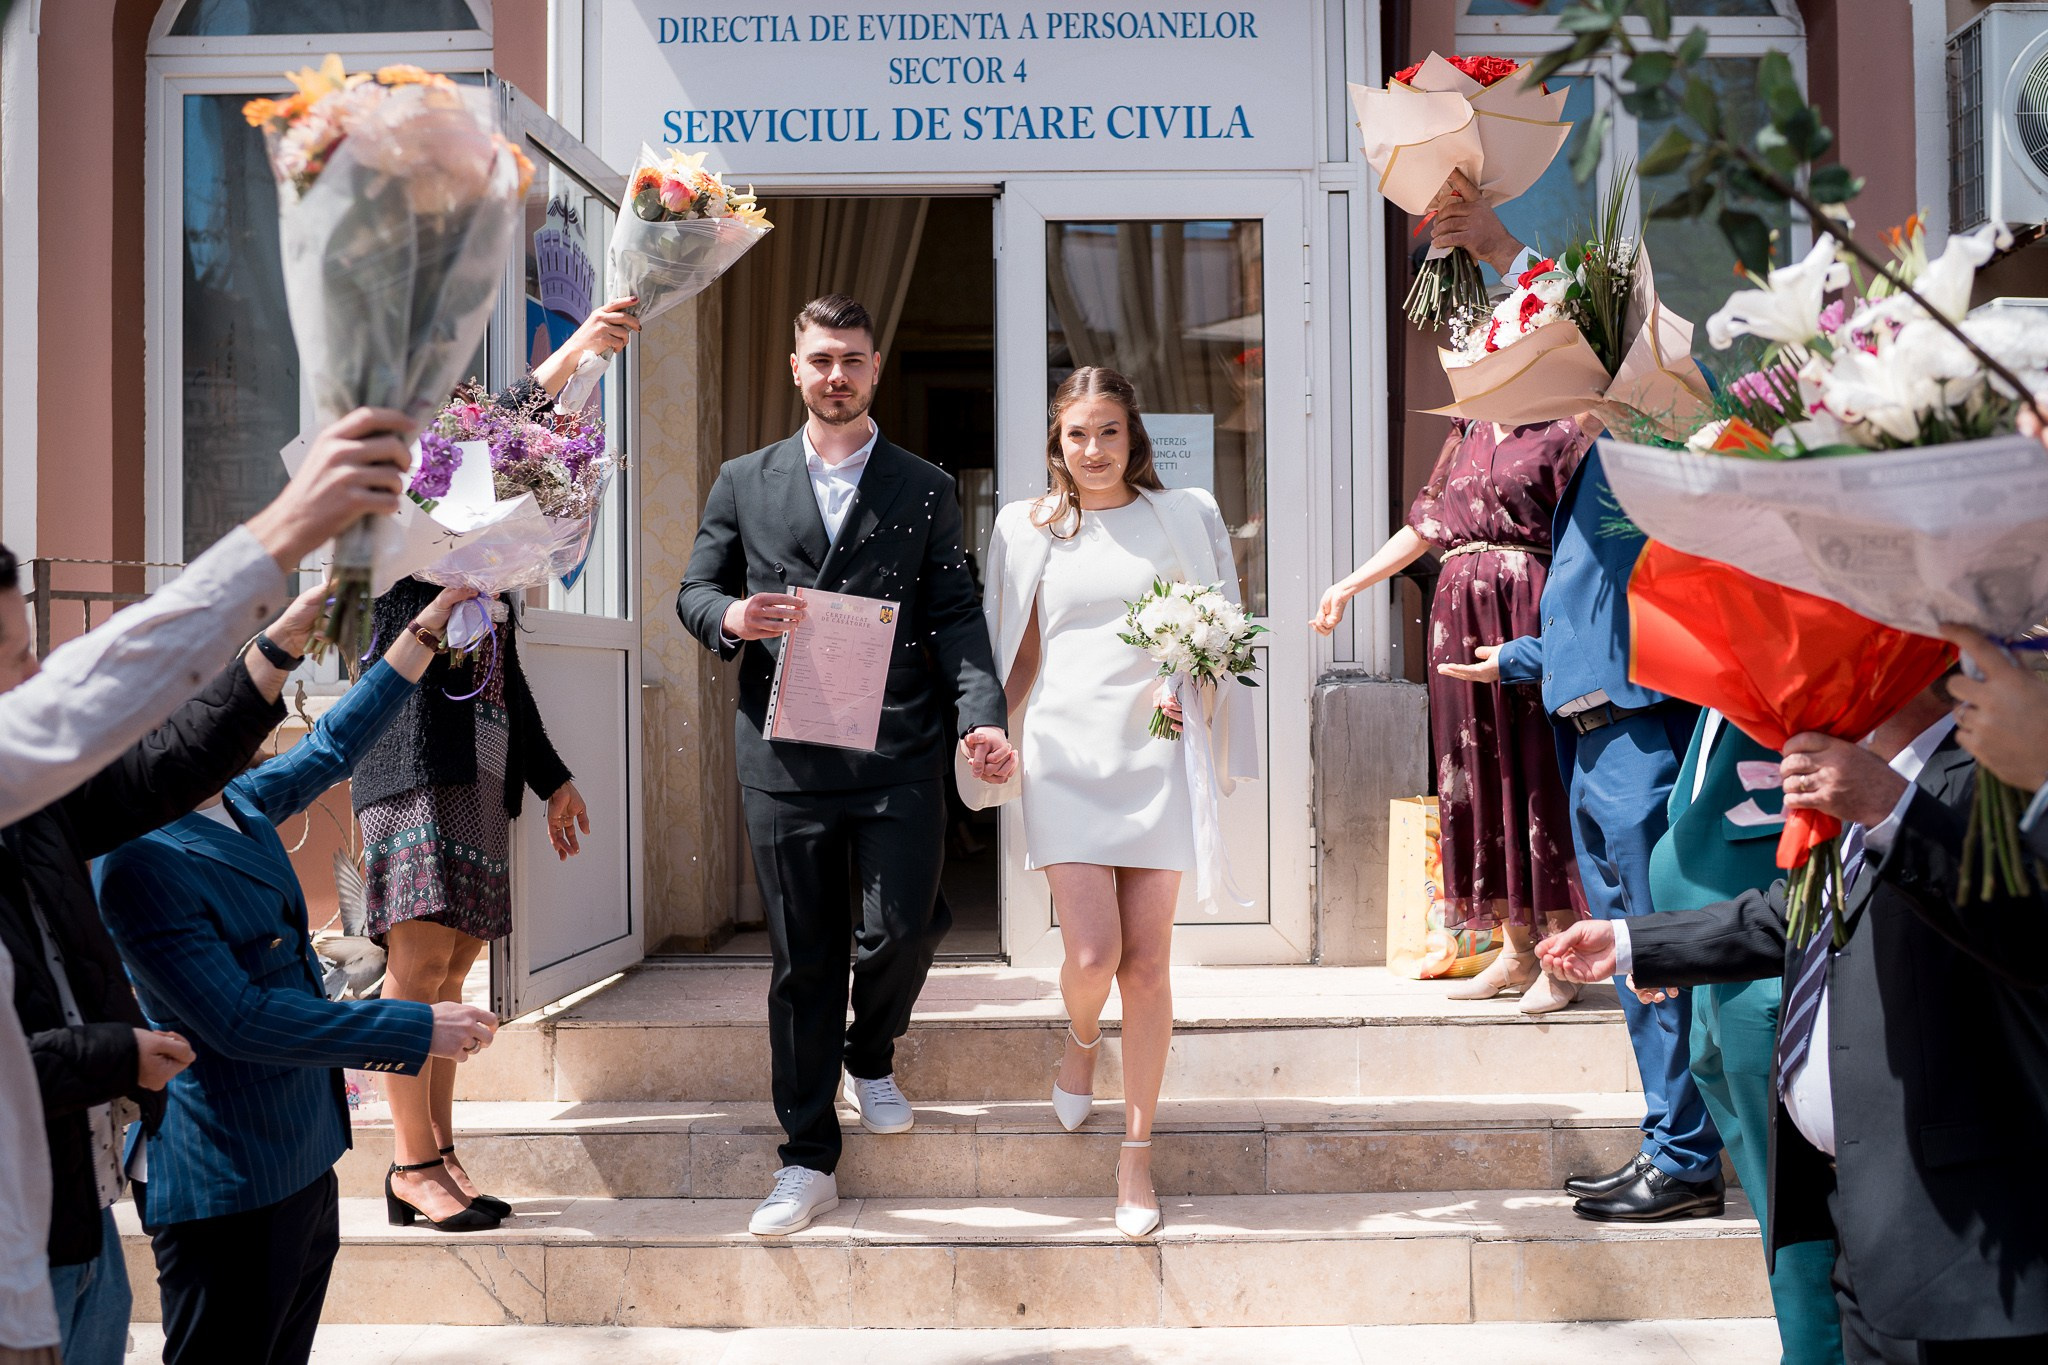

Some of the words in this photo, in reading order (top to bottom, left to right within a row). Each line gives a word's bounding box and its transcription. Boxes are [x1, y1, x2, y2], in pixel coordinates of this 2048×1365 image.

[657, 15, 800, 44] DIRECTIA
[809, 15, 849, 43] DE
[857, 13, 1010, 42] EVIDENTA
[1017, 12, 1039, 41] A
[1047, 11, 1258, 40] PERSOANELOR
[888, 56, 1005, 85] SECTOR
[1012, 57, 1028, 84] 4
[662, 107, 880, 145] SERVICIUL
[892, 106, 952, 142] DE
[962, 105, 1096, 141] STARE
[1106, 104, 1255, 140] CIVILA
[1150, 437, 1187, 446] NTERZIS
[1153, 450, 1177, 459] UNCA
[1178, 450, 1191, 459] CU
[1154, 461, 1178, 470] FETTI
